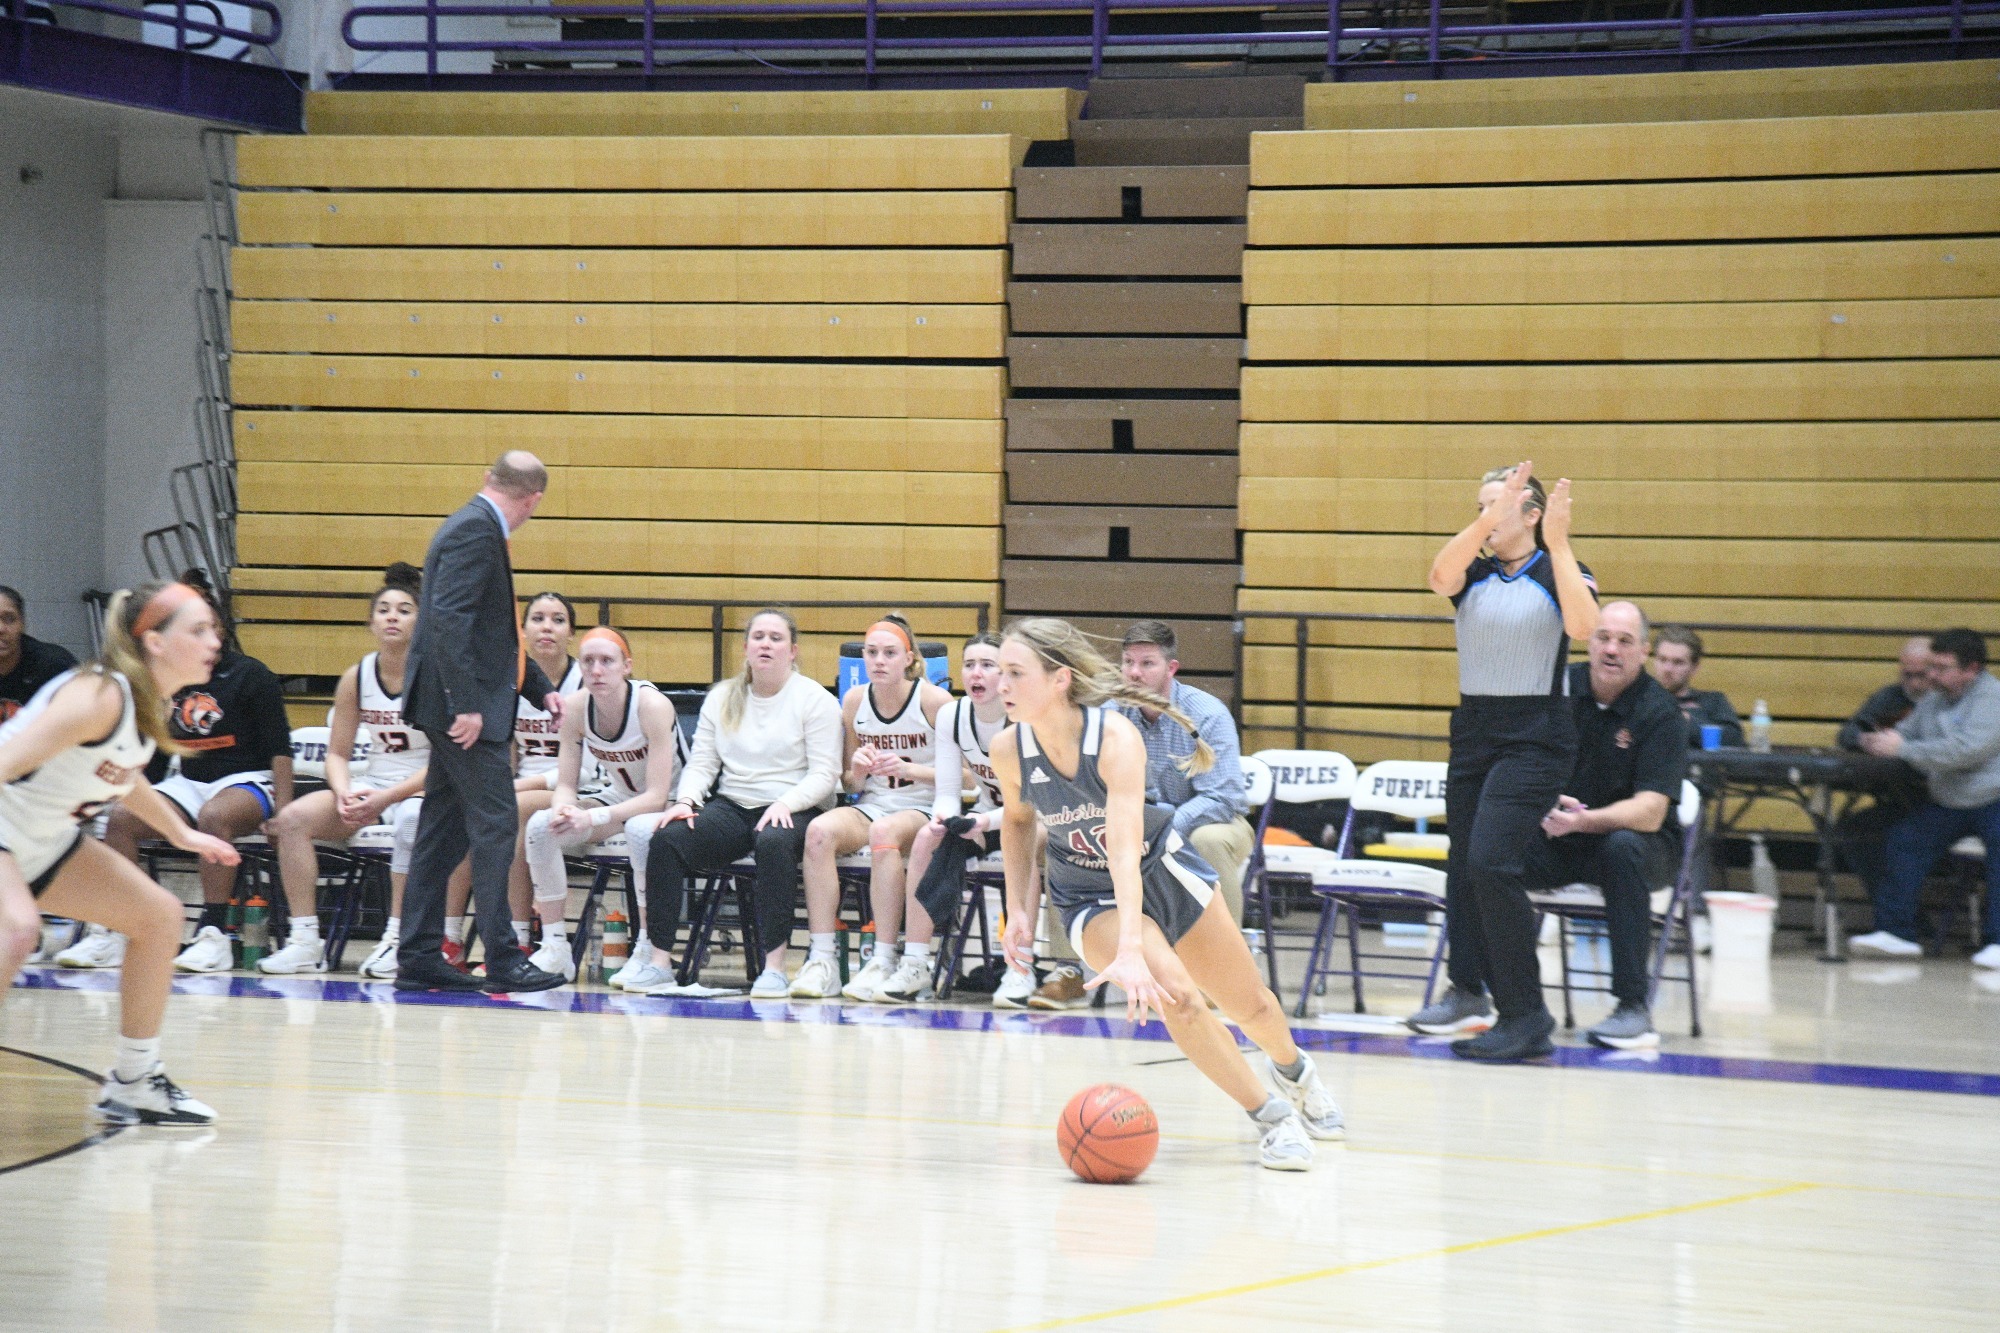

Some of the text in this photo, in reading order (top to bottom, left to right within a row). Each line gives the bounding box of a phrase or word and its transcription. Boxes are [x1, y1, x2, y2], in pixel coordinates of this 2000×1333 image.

[617, 767, 638, 793] 1
[1269, 765, 1339, 785] URPLES
[1372, 776, 1447, 799] PURPLE
